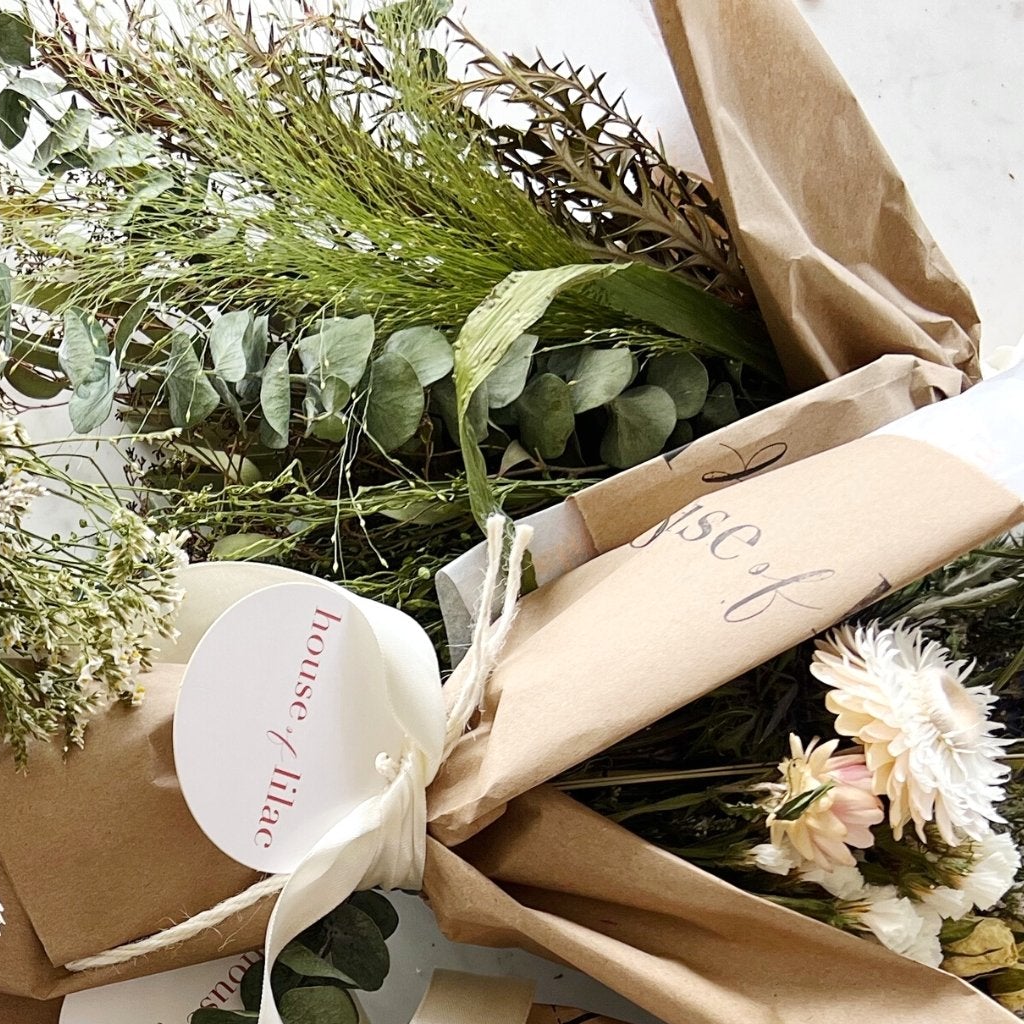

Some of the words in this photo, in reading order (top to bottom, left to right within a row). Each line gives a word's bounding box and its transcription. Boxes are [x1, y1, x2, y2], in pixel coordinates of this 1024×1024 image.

[289, 605, 343, 721] house
[265, 725, 298, 762] of
[254, 762, 302, 849] lilac
